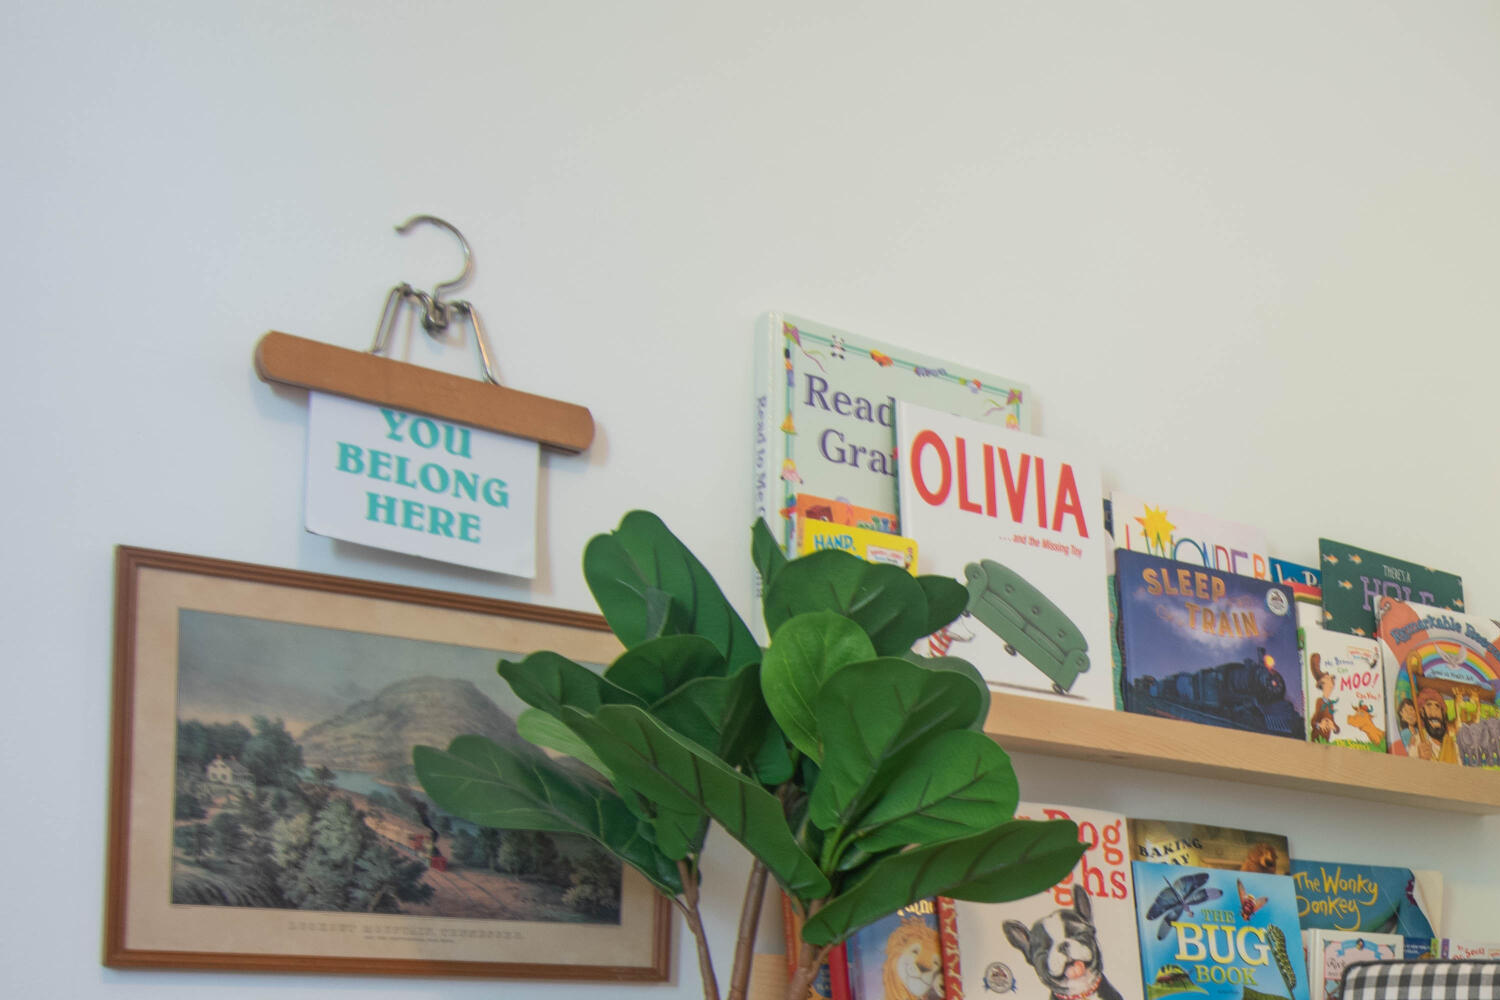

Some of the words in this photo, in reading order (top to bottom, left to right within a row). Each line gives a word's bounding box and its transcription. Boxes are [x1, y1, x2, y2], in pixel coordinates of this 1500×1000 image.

[803, 372, 896, 428] Read
[379, 408, 473, 459] YOU
[820, 428, 898, 478] Gra
[335, 440, 510, 509] BELONG
[909, 429, 1089, 539] OLIVIA
[365, 491, 482, 545] HERE
[1142, 567, 1226, 601] SLEEP
[1185, 601, 1260, 638] TRAIN
[1340, 671, 1380, 692] MOO!
[1292, 871, 1321, 893] The
[1320, 866, 1378, 907] Wonky
[1201, 908, 1236, 924] THE
[1295, 895, 1361, 932] Donkey
[1170, 920, 1271, 967] BUG
[1193, 964, 1258, 987] BOOK
